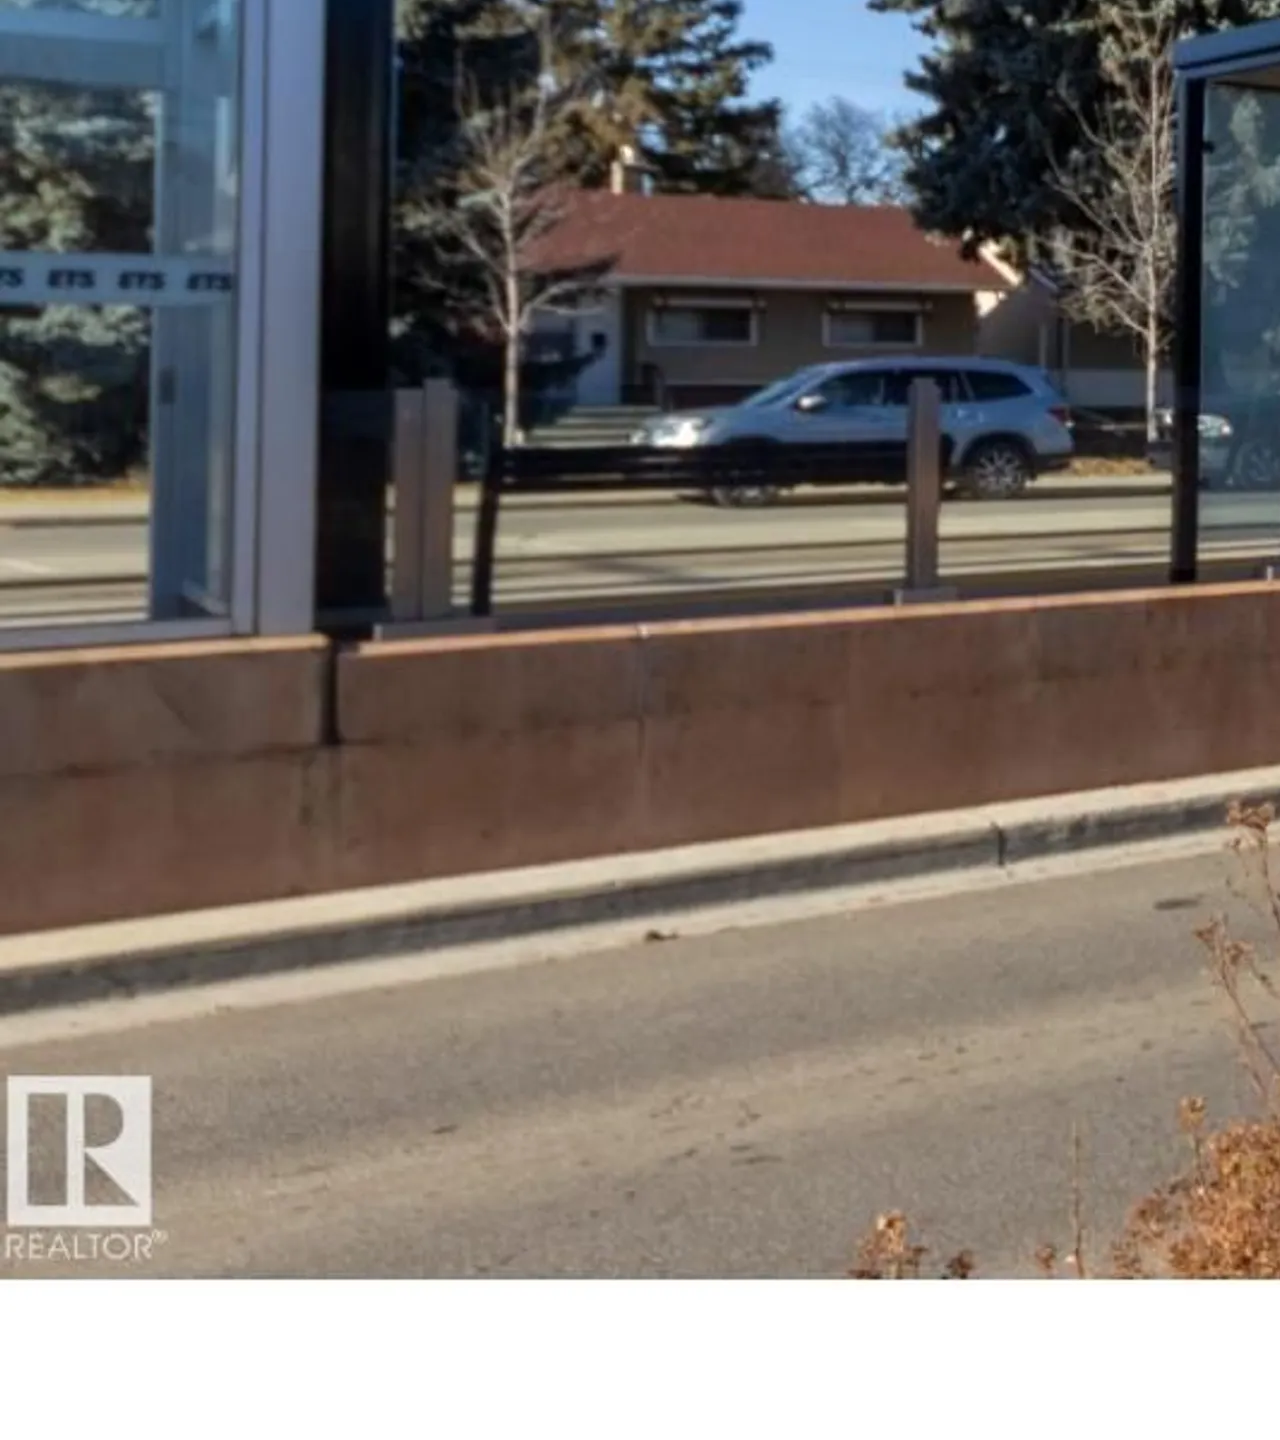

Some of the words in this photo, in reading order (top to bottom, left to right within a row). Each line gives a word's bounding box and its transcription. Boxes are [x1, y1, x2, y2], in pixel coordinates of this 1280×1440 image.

[48, 268, 95, 288] ETS
[118, 270, 164, 290] ETS
[187, 271, 232, 291] ETS
